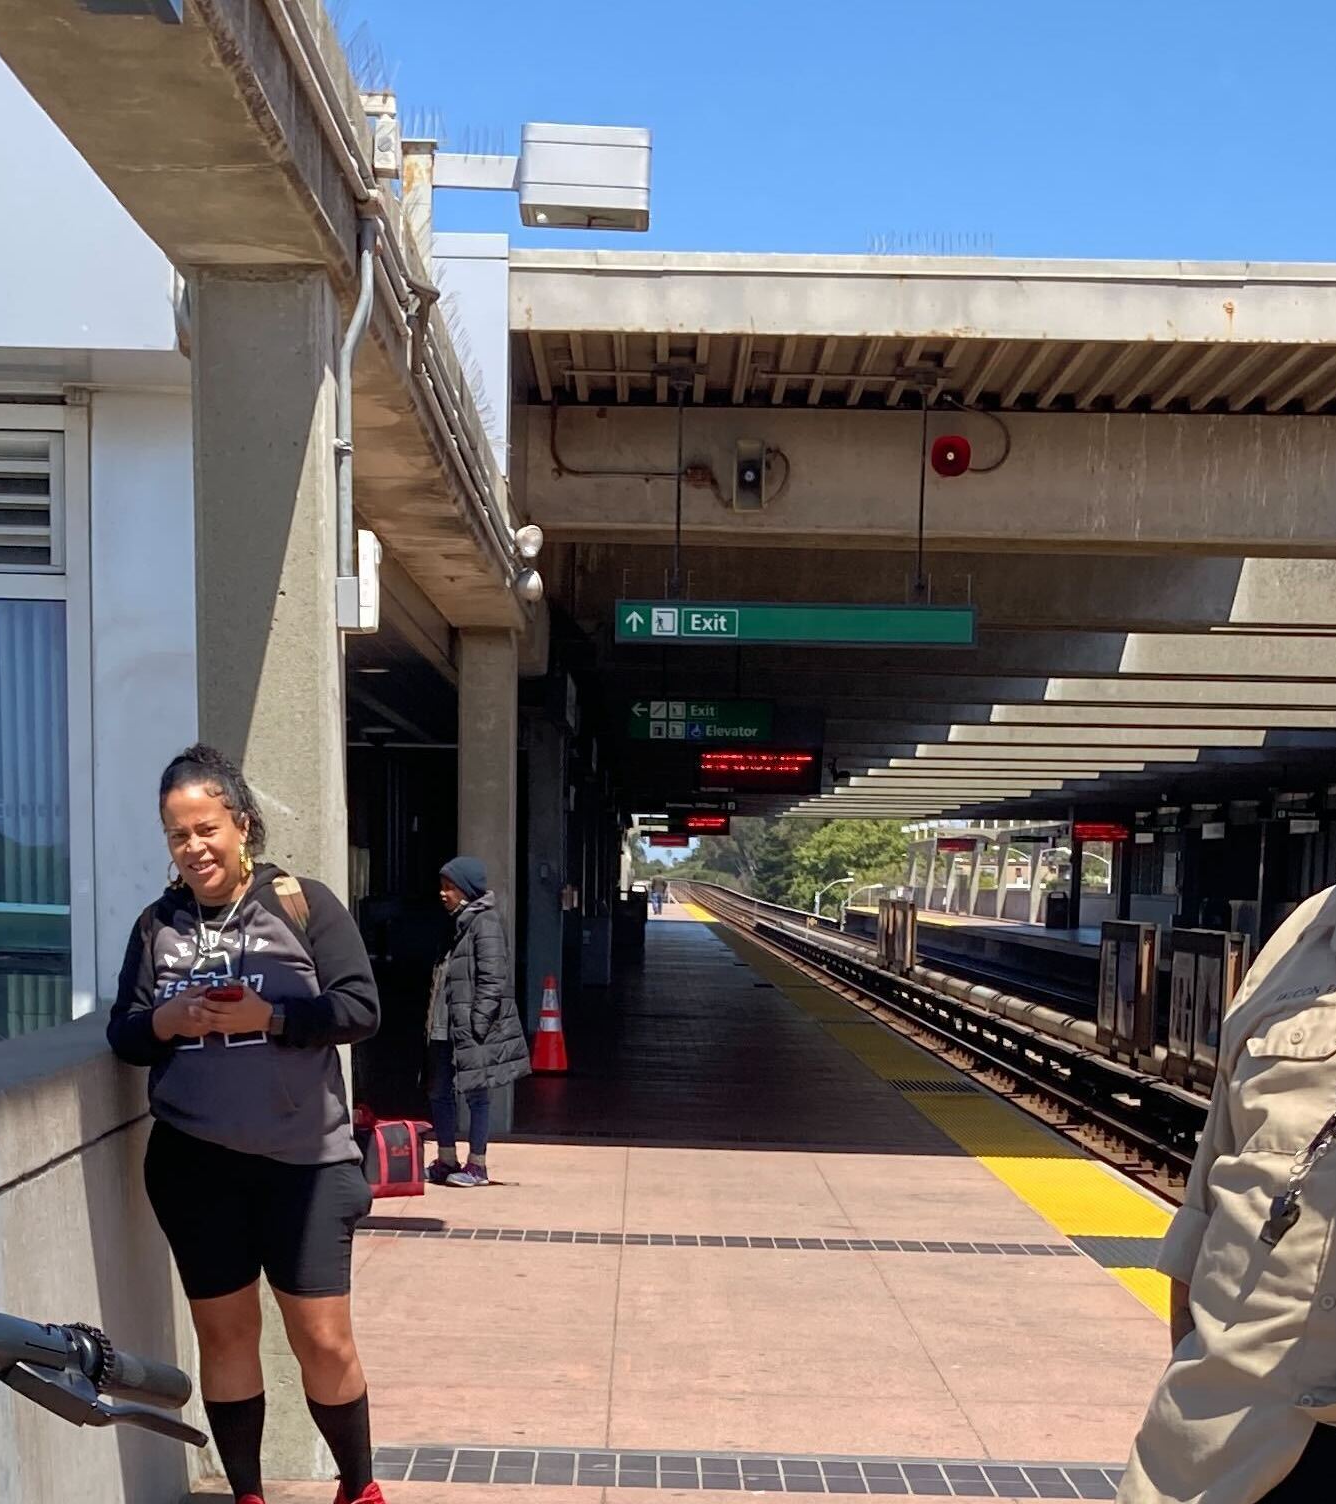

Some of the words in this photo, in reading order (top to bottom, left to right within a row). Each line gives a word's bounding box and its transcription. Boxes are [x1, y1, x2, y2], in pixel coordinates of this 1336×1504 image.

[691, 613, 727, 631] Exit
[690, 704, 714, 717] Exit
[706, 724, 758, 737] Elevator
